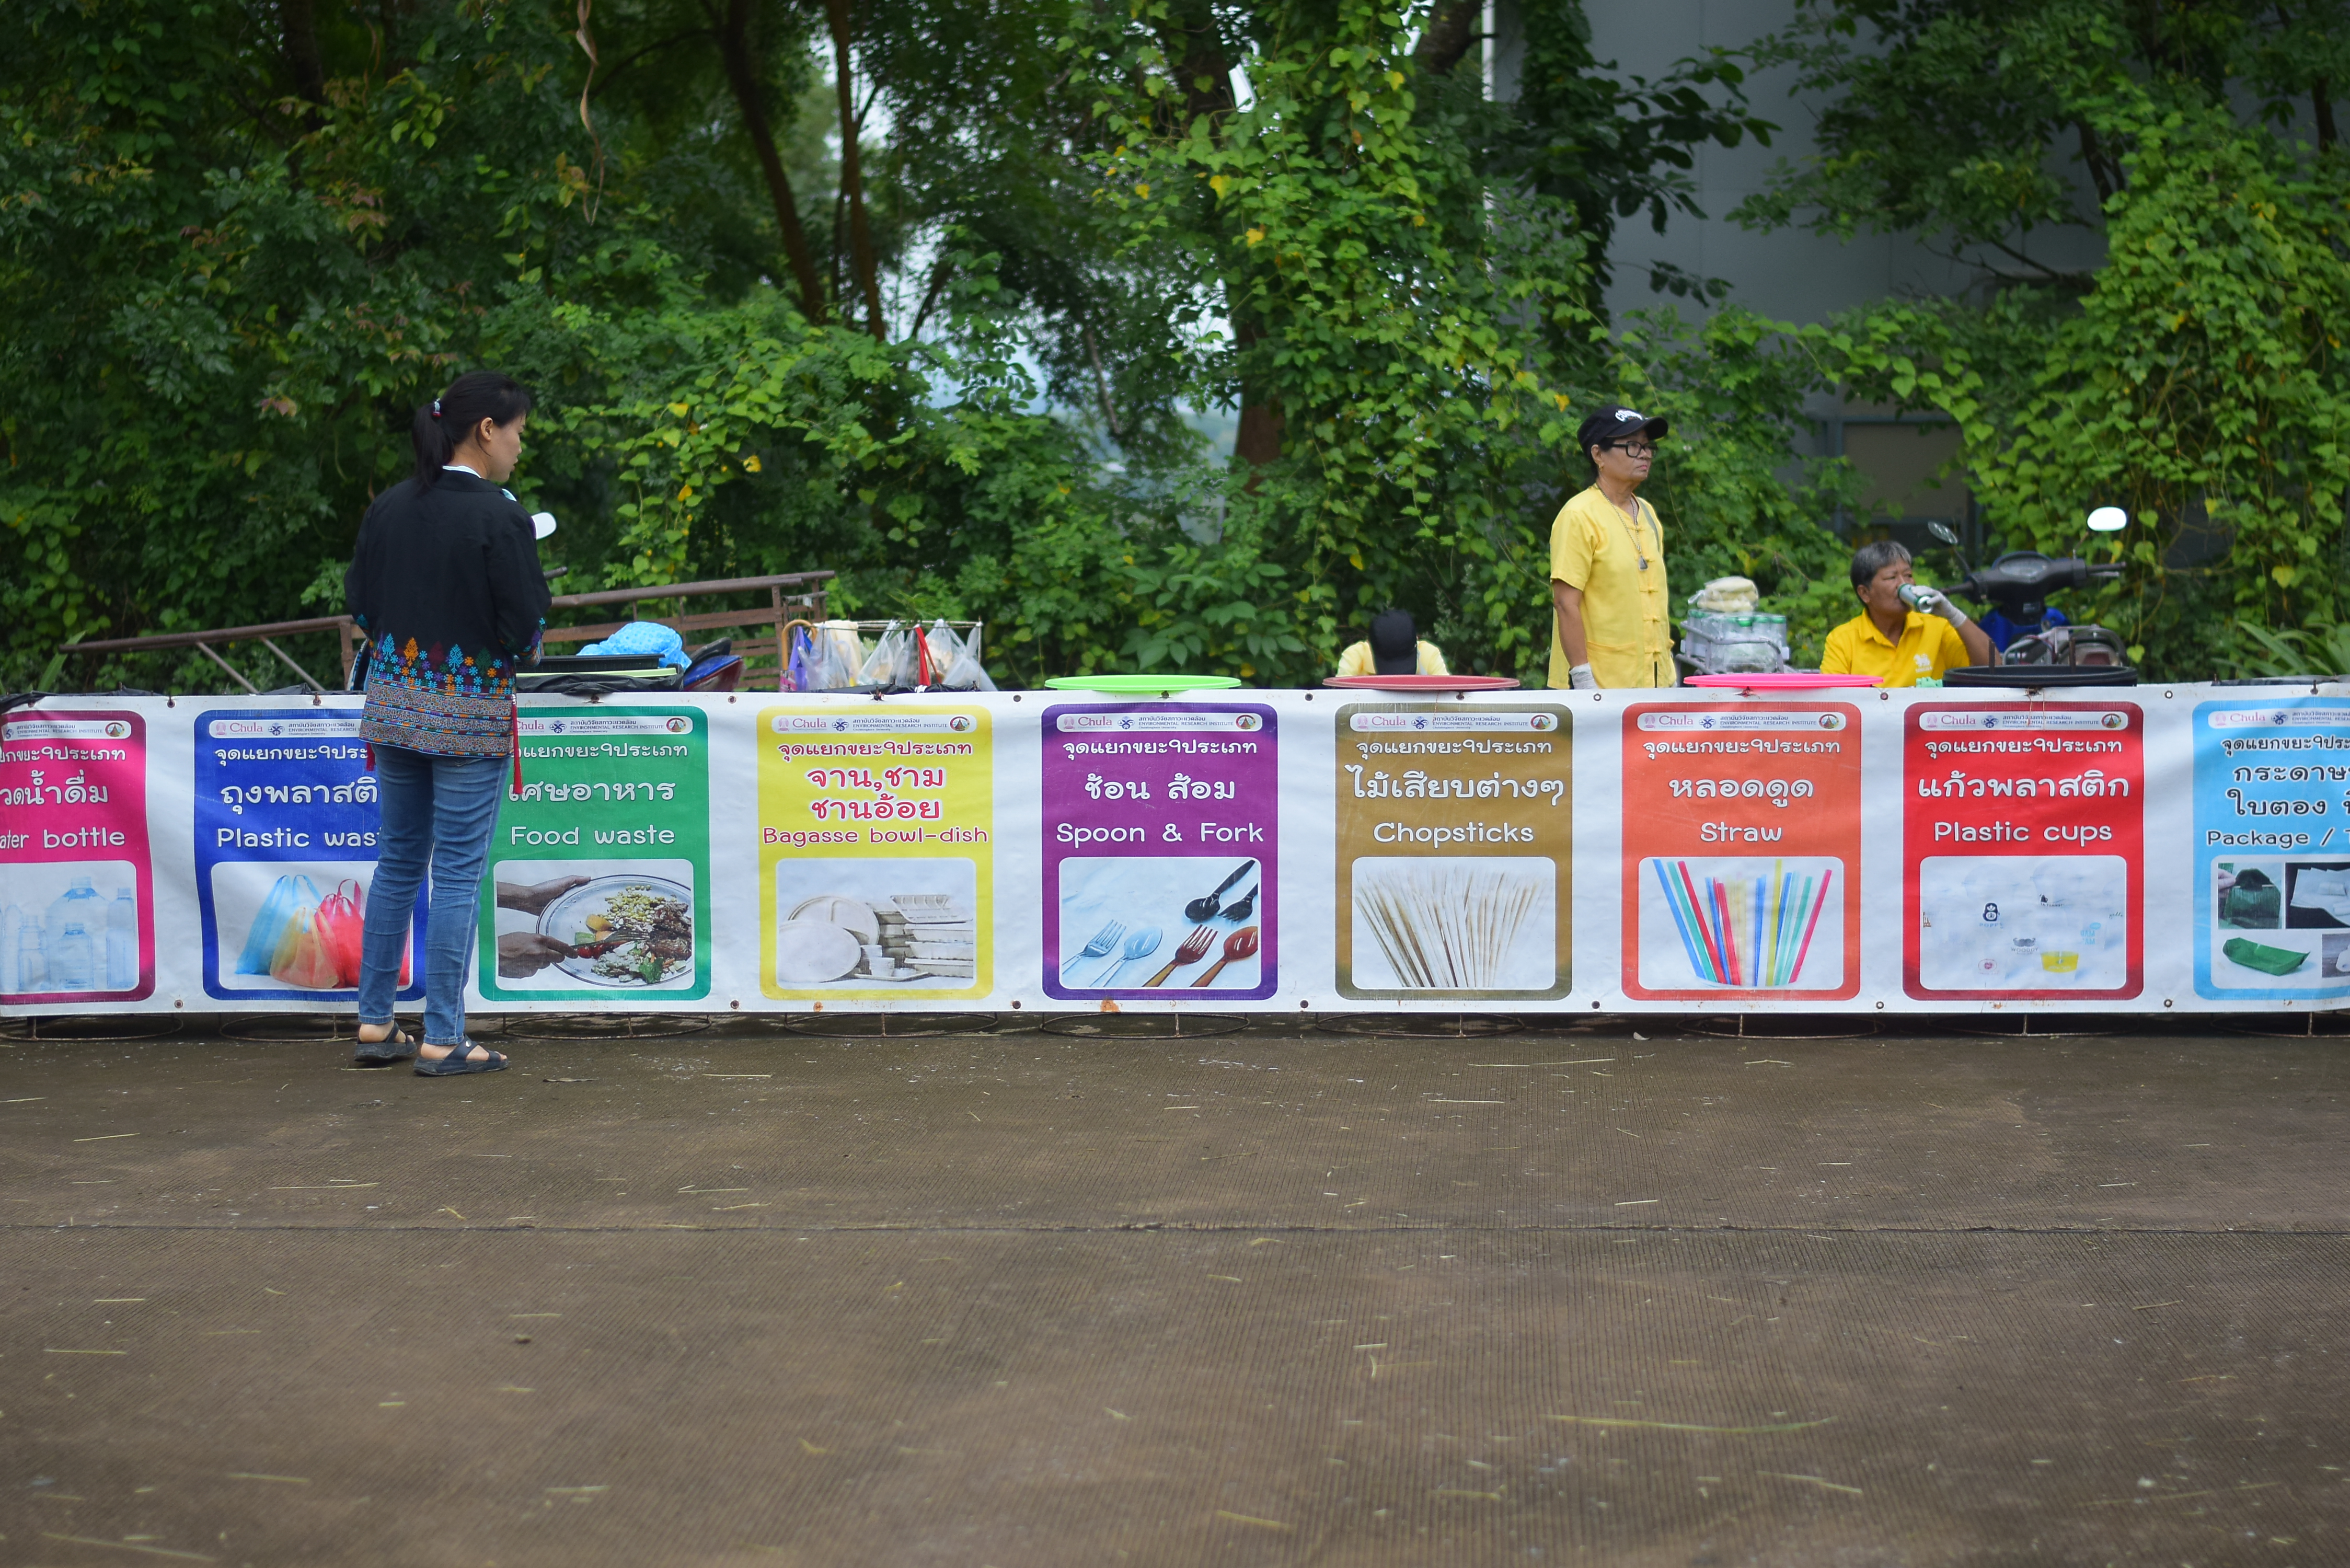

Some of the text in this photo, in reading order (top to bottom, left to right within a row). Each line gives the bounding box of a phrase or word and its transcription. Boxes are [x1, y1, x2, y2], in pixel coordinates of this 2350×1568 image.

[230, 722, 262, 732] Chula
[792, 718, 826, 728] Chula
[1078, 716, 1112, 725] Chula
[1372, 716, 1406, 725] Chula
[1659, 715, 1693, 725] Chula
[1941, 714, 1976, 724] Chula
[2230, 712, 2265, 722] Chula
[215, 745, 367, 767] จุดแยกขยะ9ประ
[808, 767, 943, 791] จาน,ชาม
[1918, 769, 2129, 797] แก้วพลาสติก
[2234, 766, 2350, 781] กระดาษ
[221, 776, 377, 814] ถุงพลาสติ
[1085, 773, 1235, 799] ช้อน ส้อม
[1669, 778, 1813, 807] หลอดดูด
[812, 793, 939, 818] ชานอ้อย
[2227, 789, 2326, 815] ใบตอง
[44, 827, 125, 848] bottle
[217, 827, 382, 847] Plastic was
[511, 824, 675, 845] Food waste
[764, 826, 987, 847] Bagasse bowl-dish
[1056, 822, 1263, 848] Spoon & Fork
[1373, 822, 1534, 848] Chopsticks
[1700, 821, 1782, 842] Straw
[1934, 821, 2112, 847] Plastic cups
[2207, 831, 2309, 849] Package
